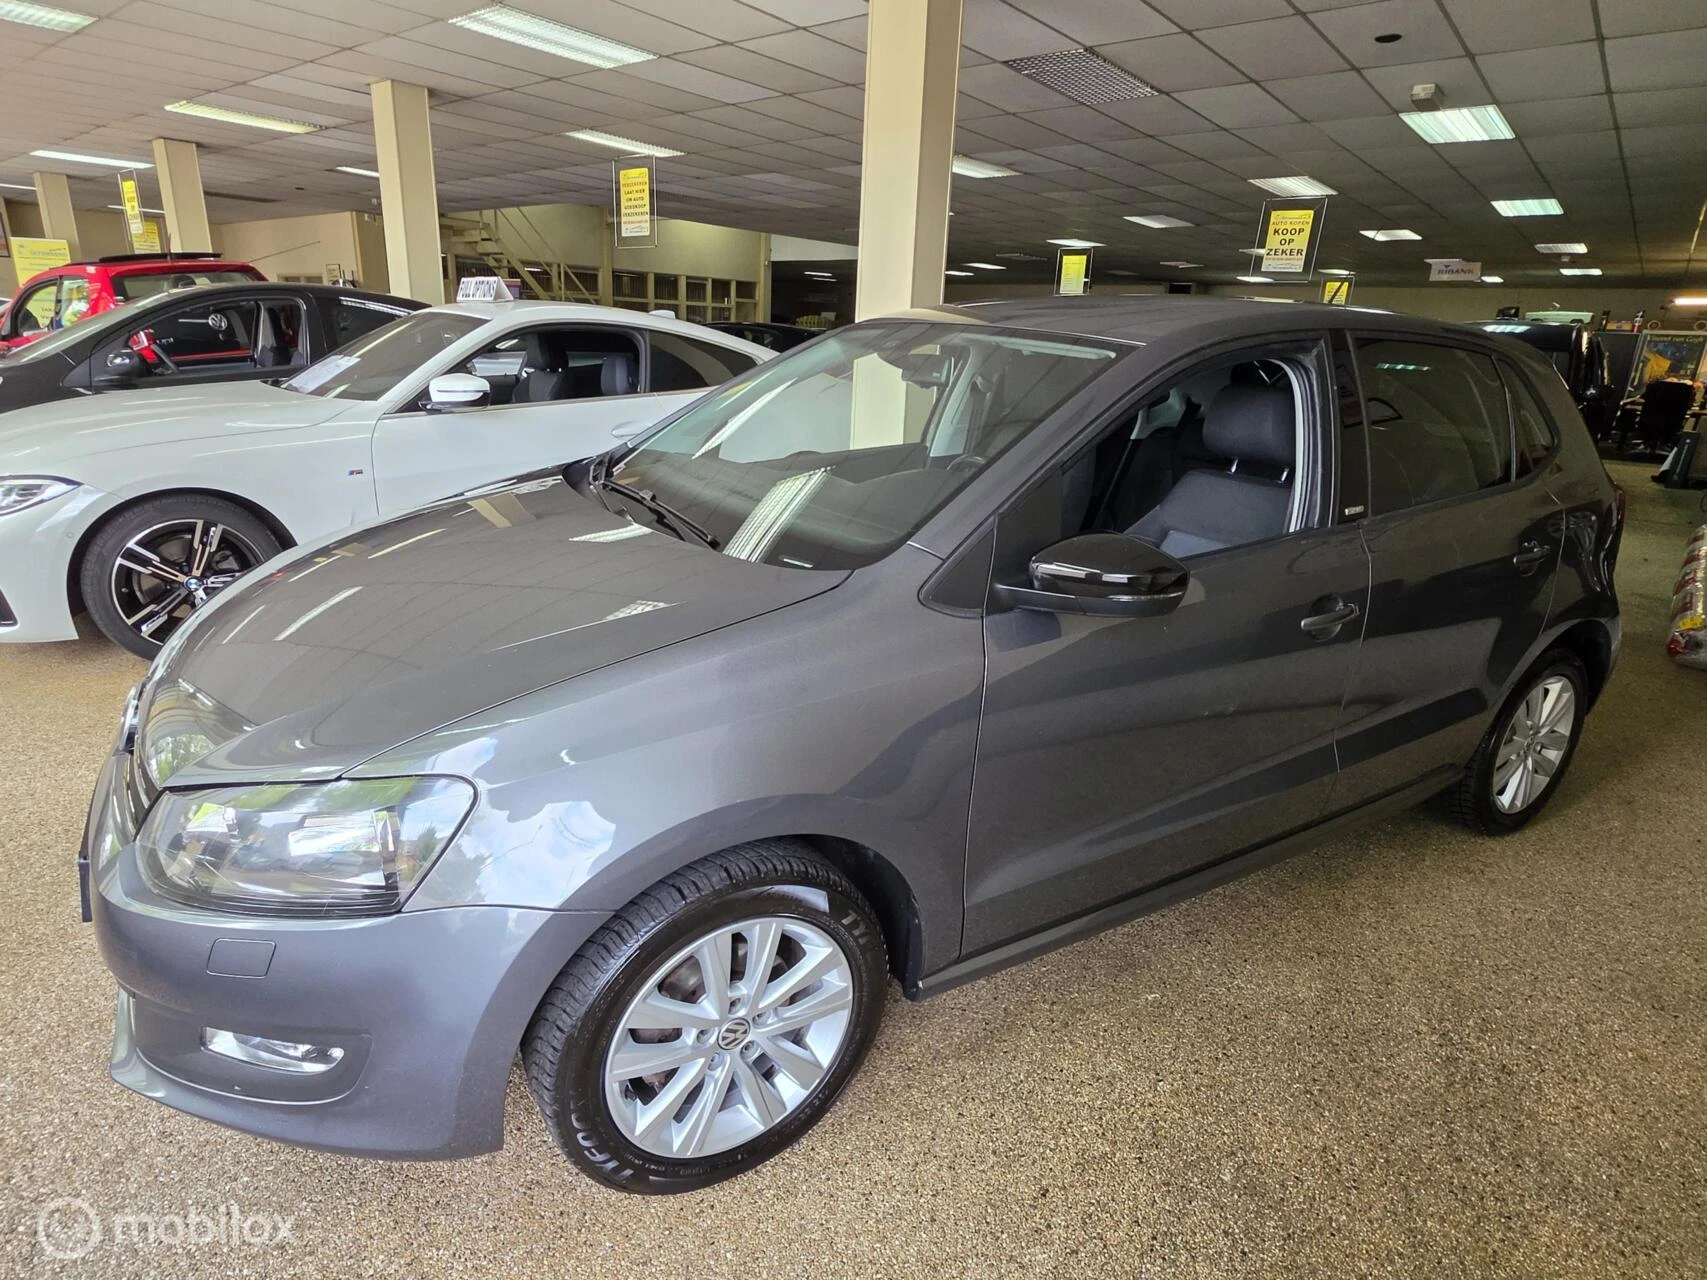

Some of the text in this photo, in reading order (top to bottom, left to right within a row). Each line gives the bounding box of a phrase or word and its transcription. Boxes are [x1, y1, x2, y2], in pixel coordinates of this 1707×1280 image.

[1273, 228, 1305, 236] KOOP
[1279, 238, 1295, 246] OP
[1266, 248, 1304, 256] ZEKER
[459, 279, 497, 298] FULL OPTIONS
